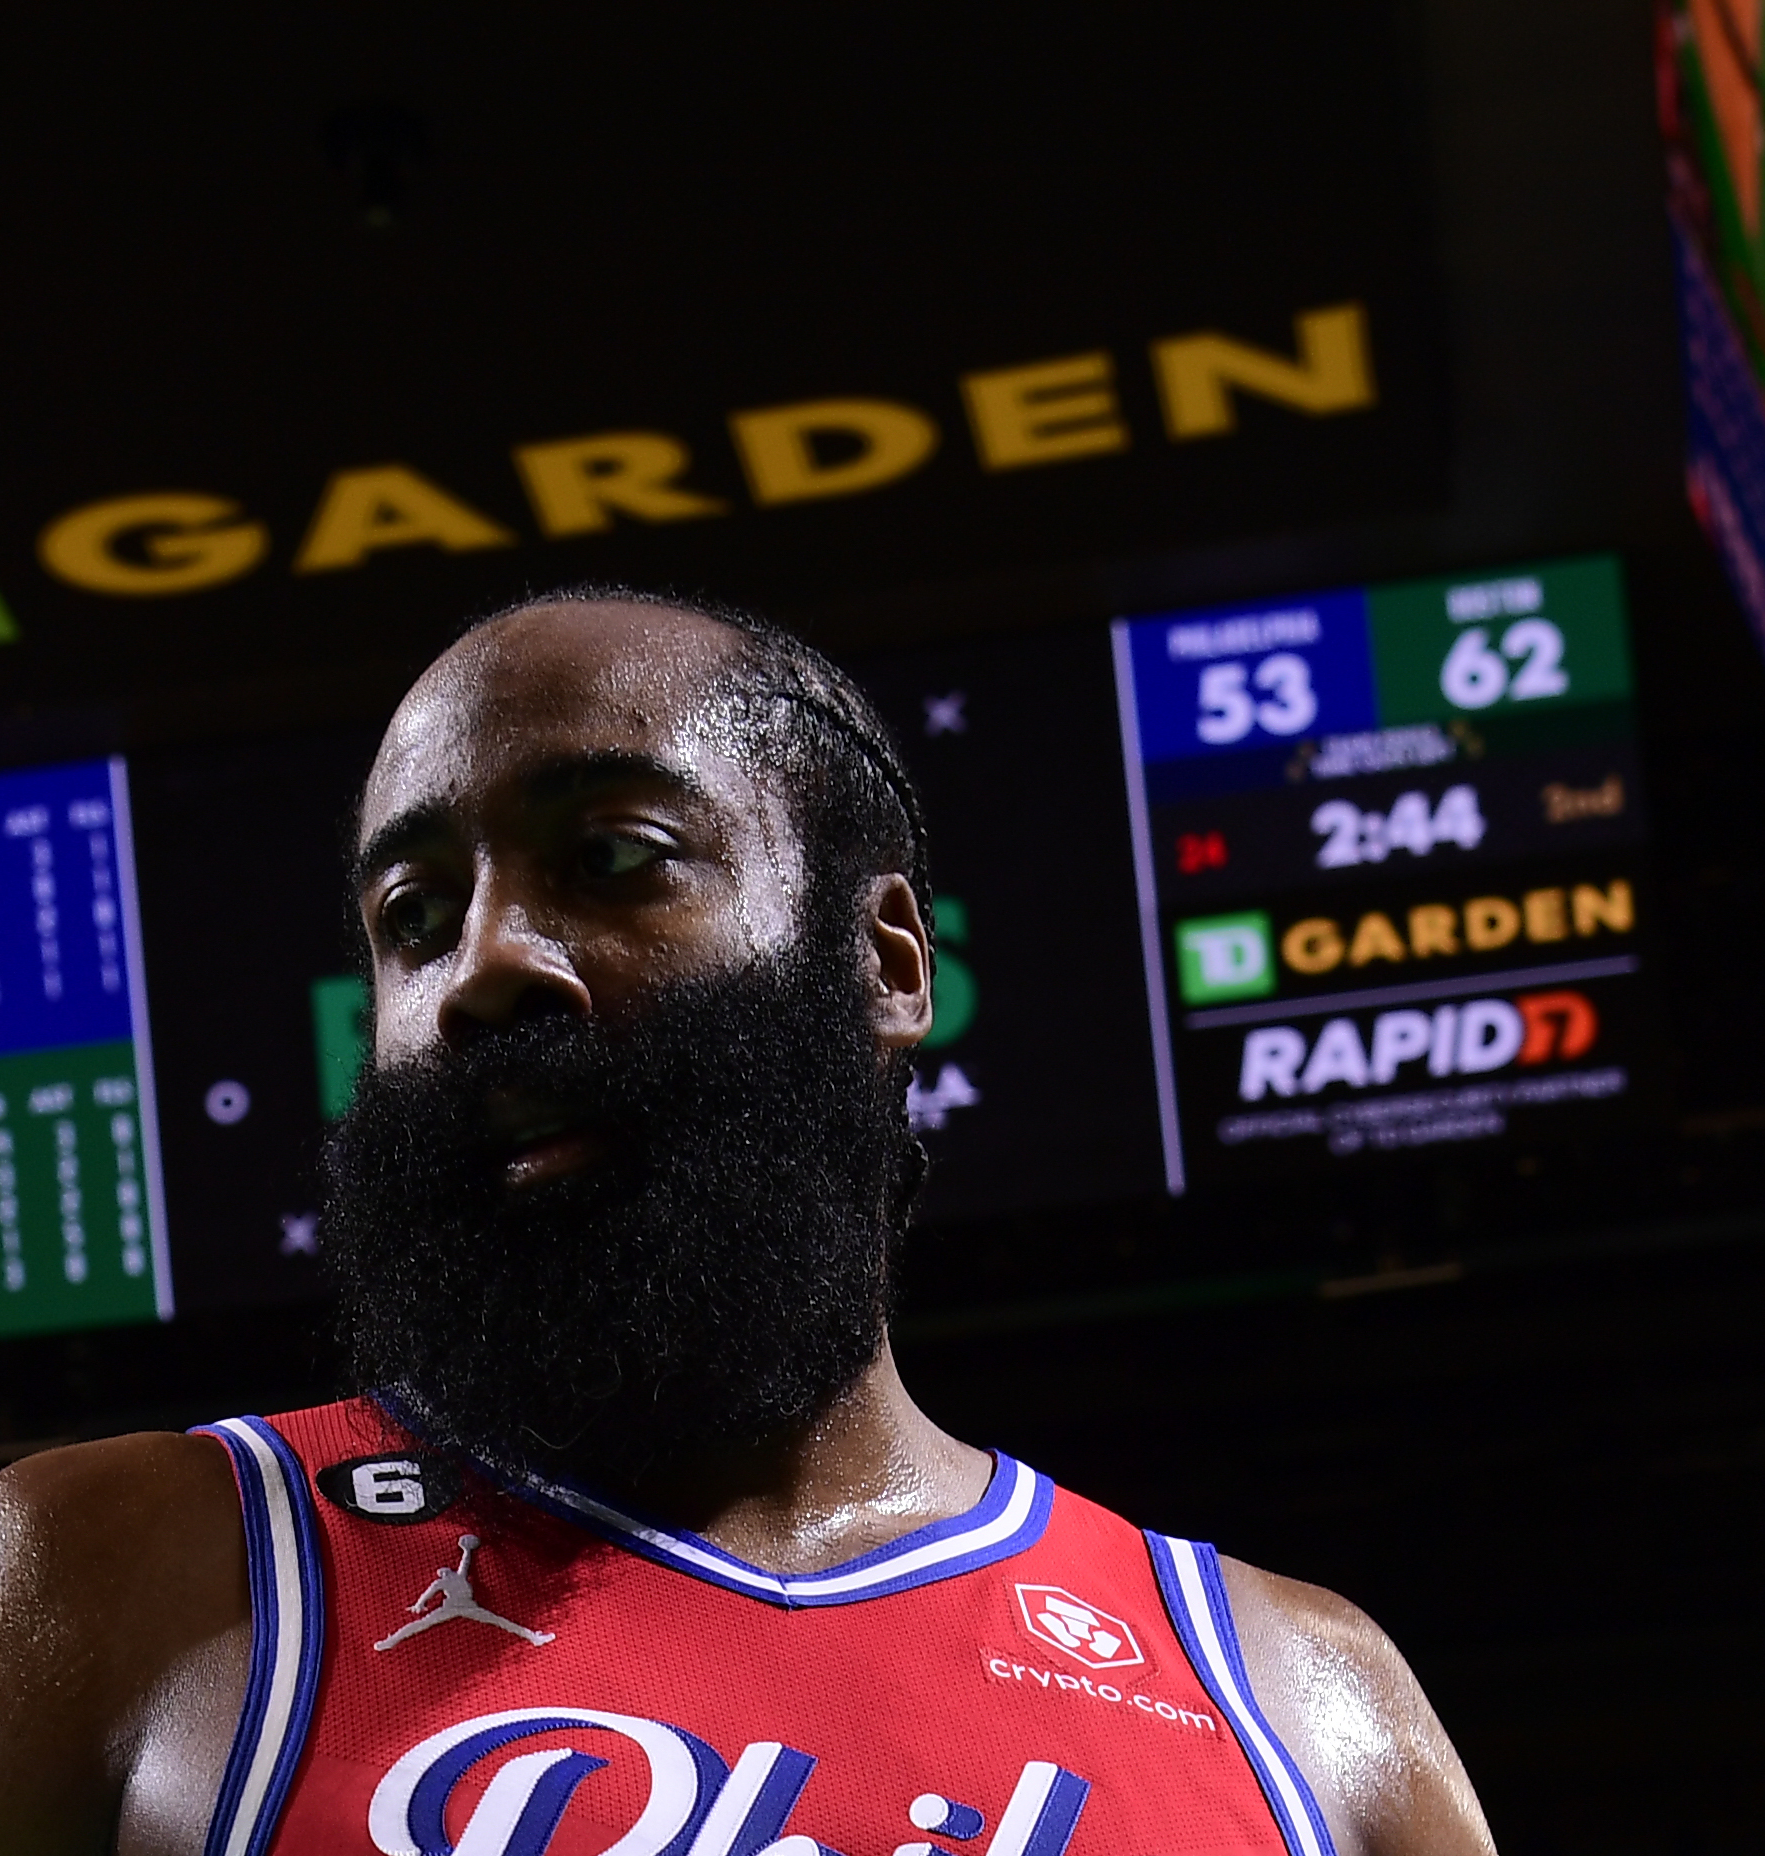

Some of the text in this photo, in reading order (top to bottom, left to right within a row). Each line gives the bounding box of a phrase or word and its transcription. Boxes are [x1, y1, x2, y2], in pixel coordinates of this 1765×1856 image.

[39, 302, 1379, 596] GARDEN
[1195, 616, 1569, 745] 53 62
[1310, 783, 1487, 871] 2:44
[1185, 879, 1633, 988] TD GARDEN
[351, 1459, 426, 1515] 6
[989, 1655, 1217, 1732] crypto.com
